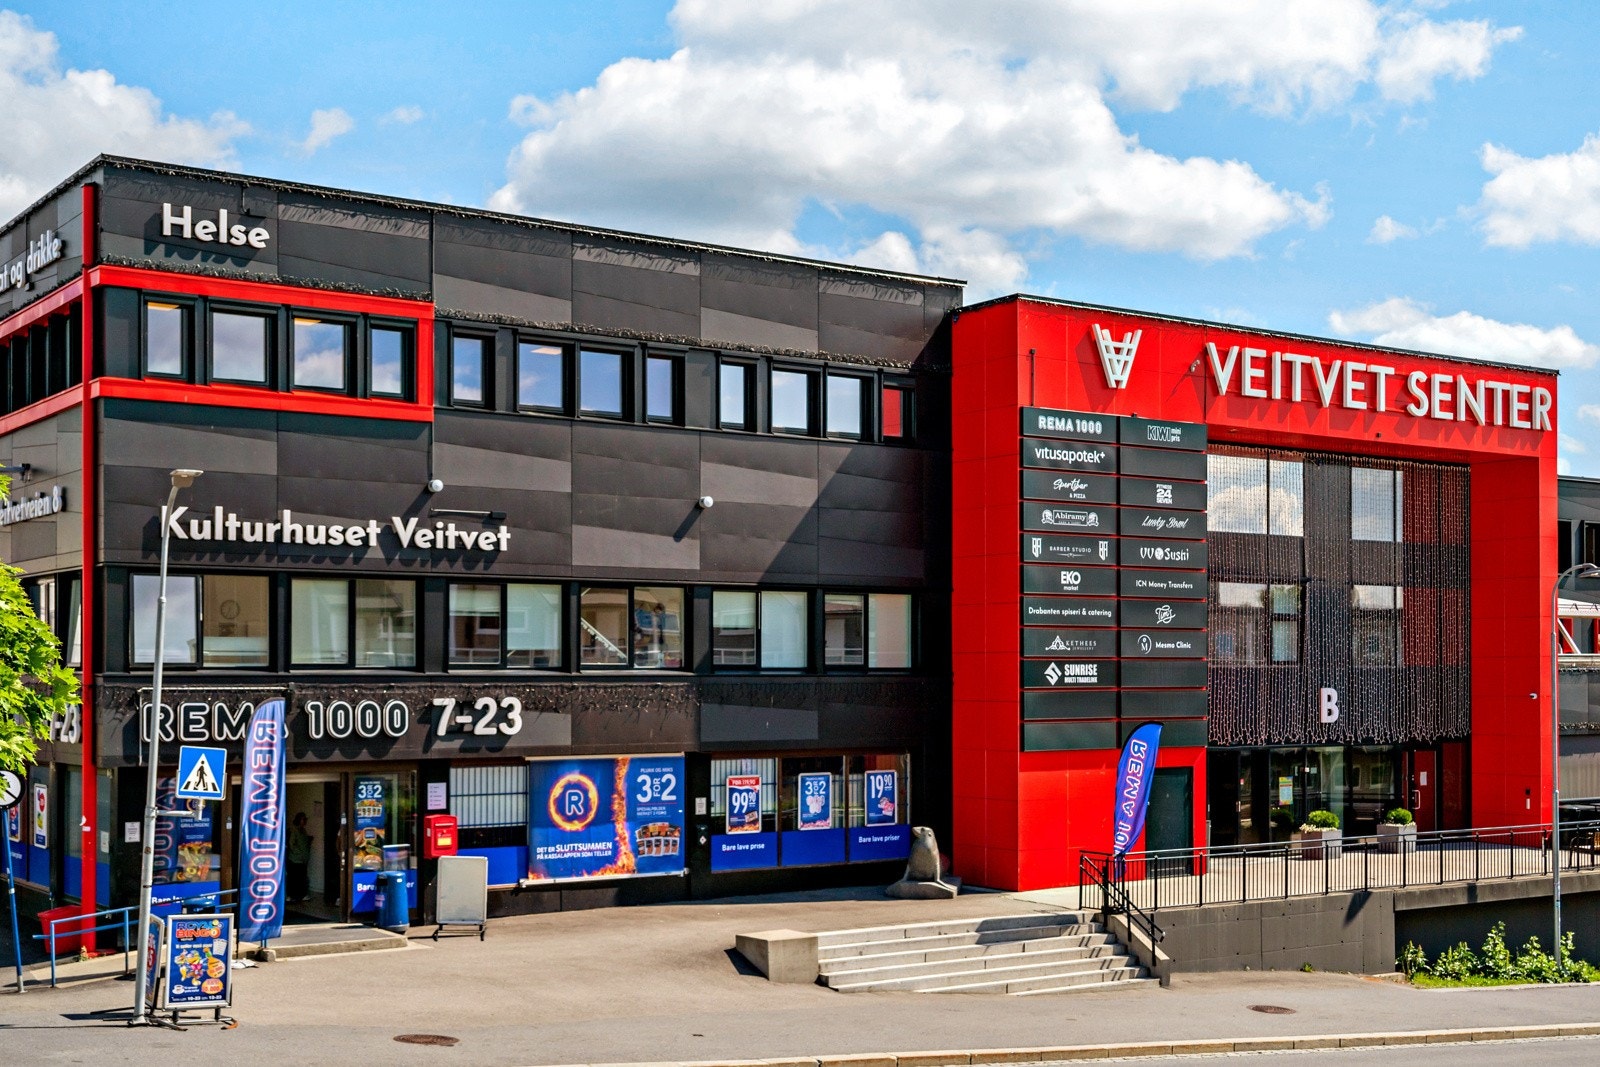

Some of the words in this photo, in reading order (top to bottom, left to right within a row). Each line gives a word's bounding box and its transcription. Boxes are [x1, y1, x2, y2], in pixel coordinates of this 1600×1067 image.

[162, 203, 270, 249] Helse
[11, 261, 25, 289] og
[27, 230, 62, 274] drikke
[1206, 342, 1395, 413] VEITVET
[1406, 370, 1552, 432] SENTER
[1038, 415, 1074, 432] REMA
[1075, 418, 1103, 435] 1000
[1147, 425, 1171, 442] KIWI
[52, 485, 62, 512] 8
[1156, 489, 1172, 498] 24
[1055, 512, 1086, 522] Abiramy
[161, 506, 381, 547] Kulturhuset
[392, 517, 511, 551] Veitvet
[1164, 548, 1189, 561] Sushi
[1061, 570, 1081, 584] EKO
[1148, 581, 1167, 589] Money
[1168, 581, 1193, 589] Transfers
[1028, 606, 1060, 615] Drabanten
[1061, 608, 1081, 616] spiseri
[1088, 609, 1112, 617] catering
[1155, 641, 1175, 649] Mesmo
[1176, 640, 1192, 649] Clinic
[1064, 663, 1098, 676] SUNRISE
[1320, 687, 1339, 724] B
[305, 699, 409, 739] 1000
[433, 697, 523, 736] 7-23
[653, 778, 661, 797] FOR
[565, 789, 585, 816] R
[884, 834, 900, 842] priser
[556, 842, 613, 852] SLUTTSUMMEN
[722, 844, 736, 852] Bare
[176, 927, 221, 938] BINGO
